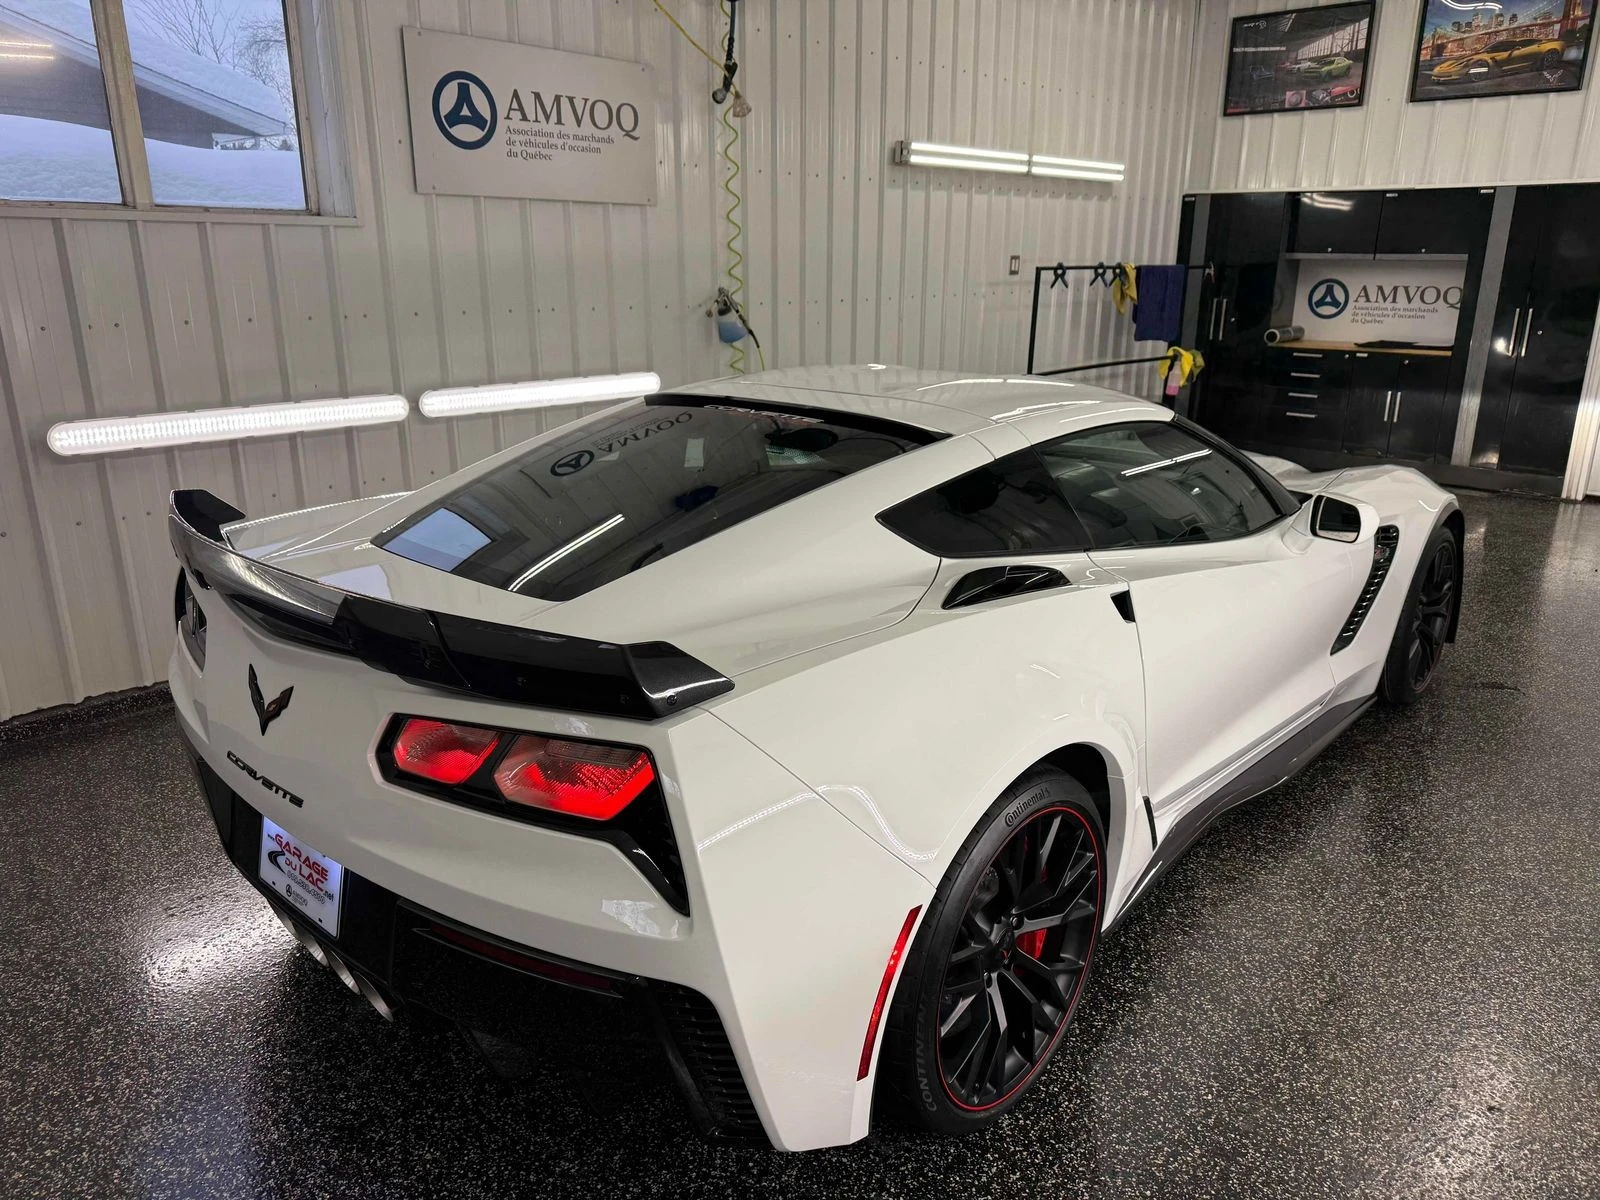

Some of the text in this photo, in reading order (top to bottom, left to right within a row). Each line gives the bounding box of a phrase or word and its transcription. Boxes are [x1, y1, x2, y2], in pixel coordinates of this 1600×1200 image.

[504, 88, 640, 141] AMVOQ
[505, 126, 615, 145] Association des marchands
[506, 137, 601, 154] de véhicules d'occasion
[507, 148, 553, 162] du Québec
[1353, 285, 1464, 310] AMVOQ
[227, 750, 304, 808] CORVETTE
[1005, 789, 1046, 828] Continental
[275, 834, 328, 881] GARAGE
[284, 858, 297, 871] DU
[299, 865, 325, 893] LAC
